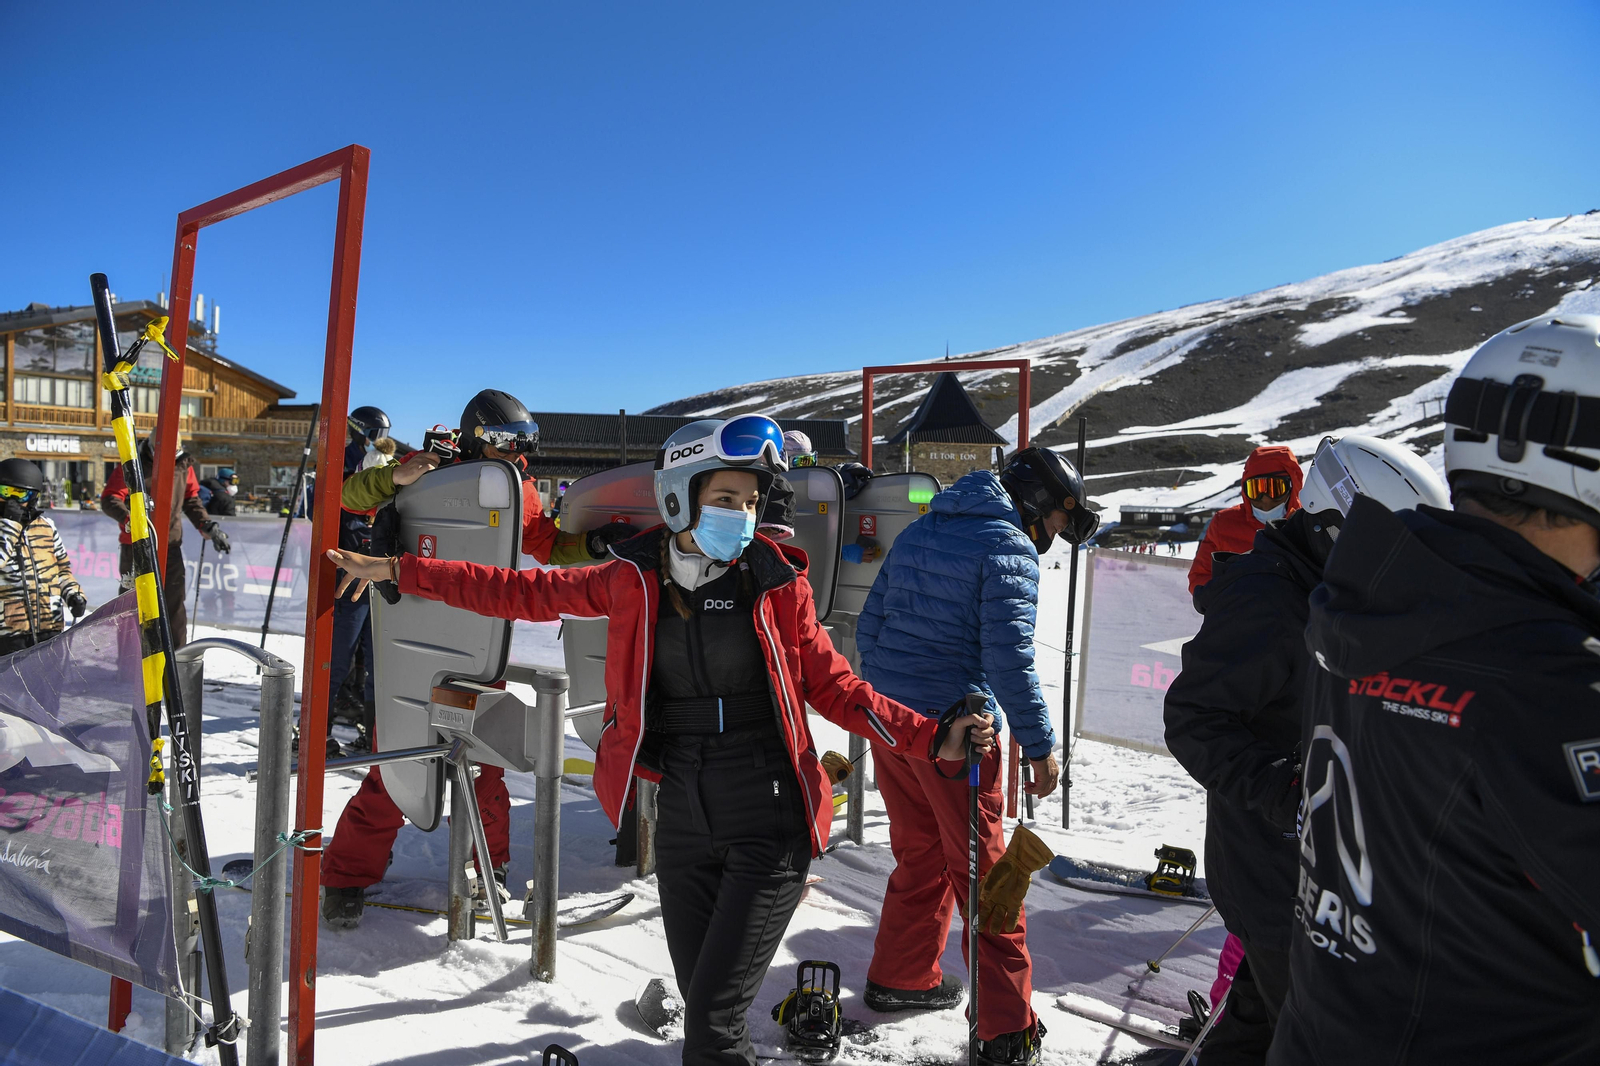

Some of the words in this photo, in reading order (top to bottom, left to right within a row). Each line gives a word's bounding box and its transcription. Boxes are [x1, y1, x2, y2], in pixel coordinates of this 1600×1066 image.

[930, 452, 938, 460] EL
[491, 513, 497, 524] 1
[920, 505, 926, 513] 4
[1064, 634, 1073, 670] LISKI
[1382, 700, 1399, 713] THE
[1399, 704, 1431, 720] SWISS
[1430, 711, 1449, 725] SKI
[175, 721, 194, 799] LISKI
[969, 839, 977, 880] LEKI
